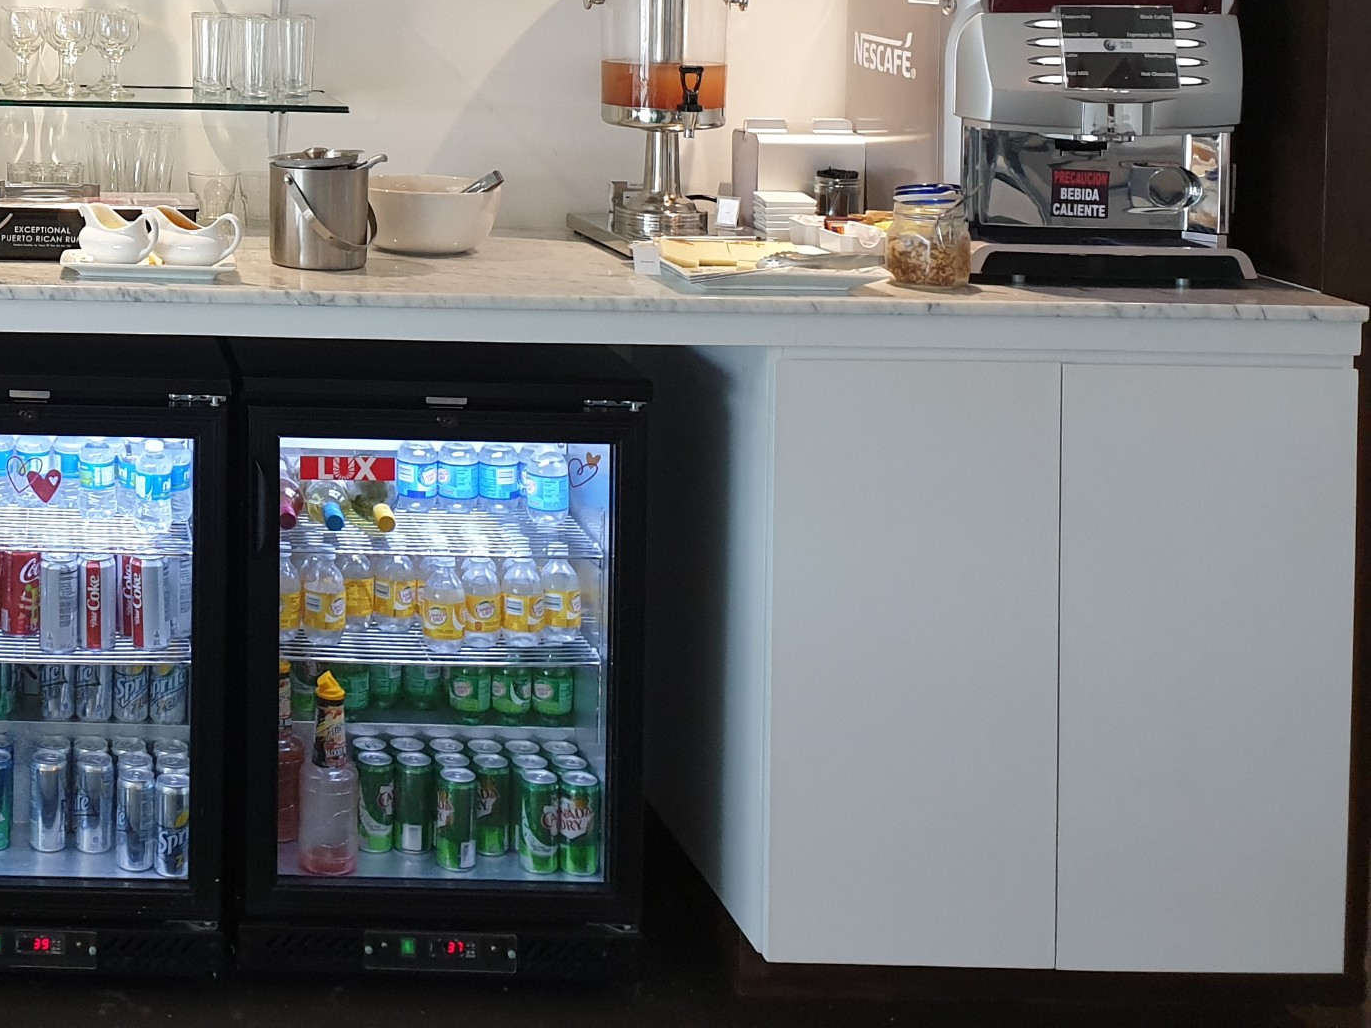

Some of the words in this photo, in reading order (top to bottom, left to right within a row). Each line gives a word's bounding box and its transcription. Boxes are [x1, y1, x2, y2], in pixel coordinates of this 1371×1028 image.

[853, 31, 912, 79] NESCAFÉ
[1054, 171, 1107, 185] PRECAUCION
[1060, 187, 1100, 201] BEBIDA
[1053, 203, 1106, 217] CALIENTE
[14, 226, 71, 234] EXCEPTIONAL
[1, 235, 33, 243] PUERTO
[35, 235, 63, 243] RICAN
[317, 456, 377, 481] LUX
[87, 575, 100, 611] Coke
[133, 573, 142, 609] Coke
[34, 939, 50, 951] 39
[447, 941, 465, 954] 37
